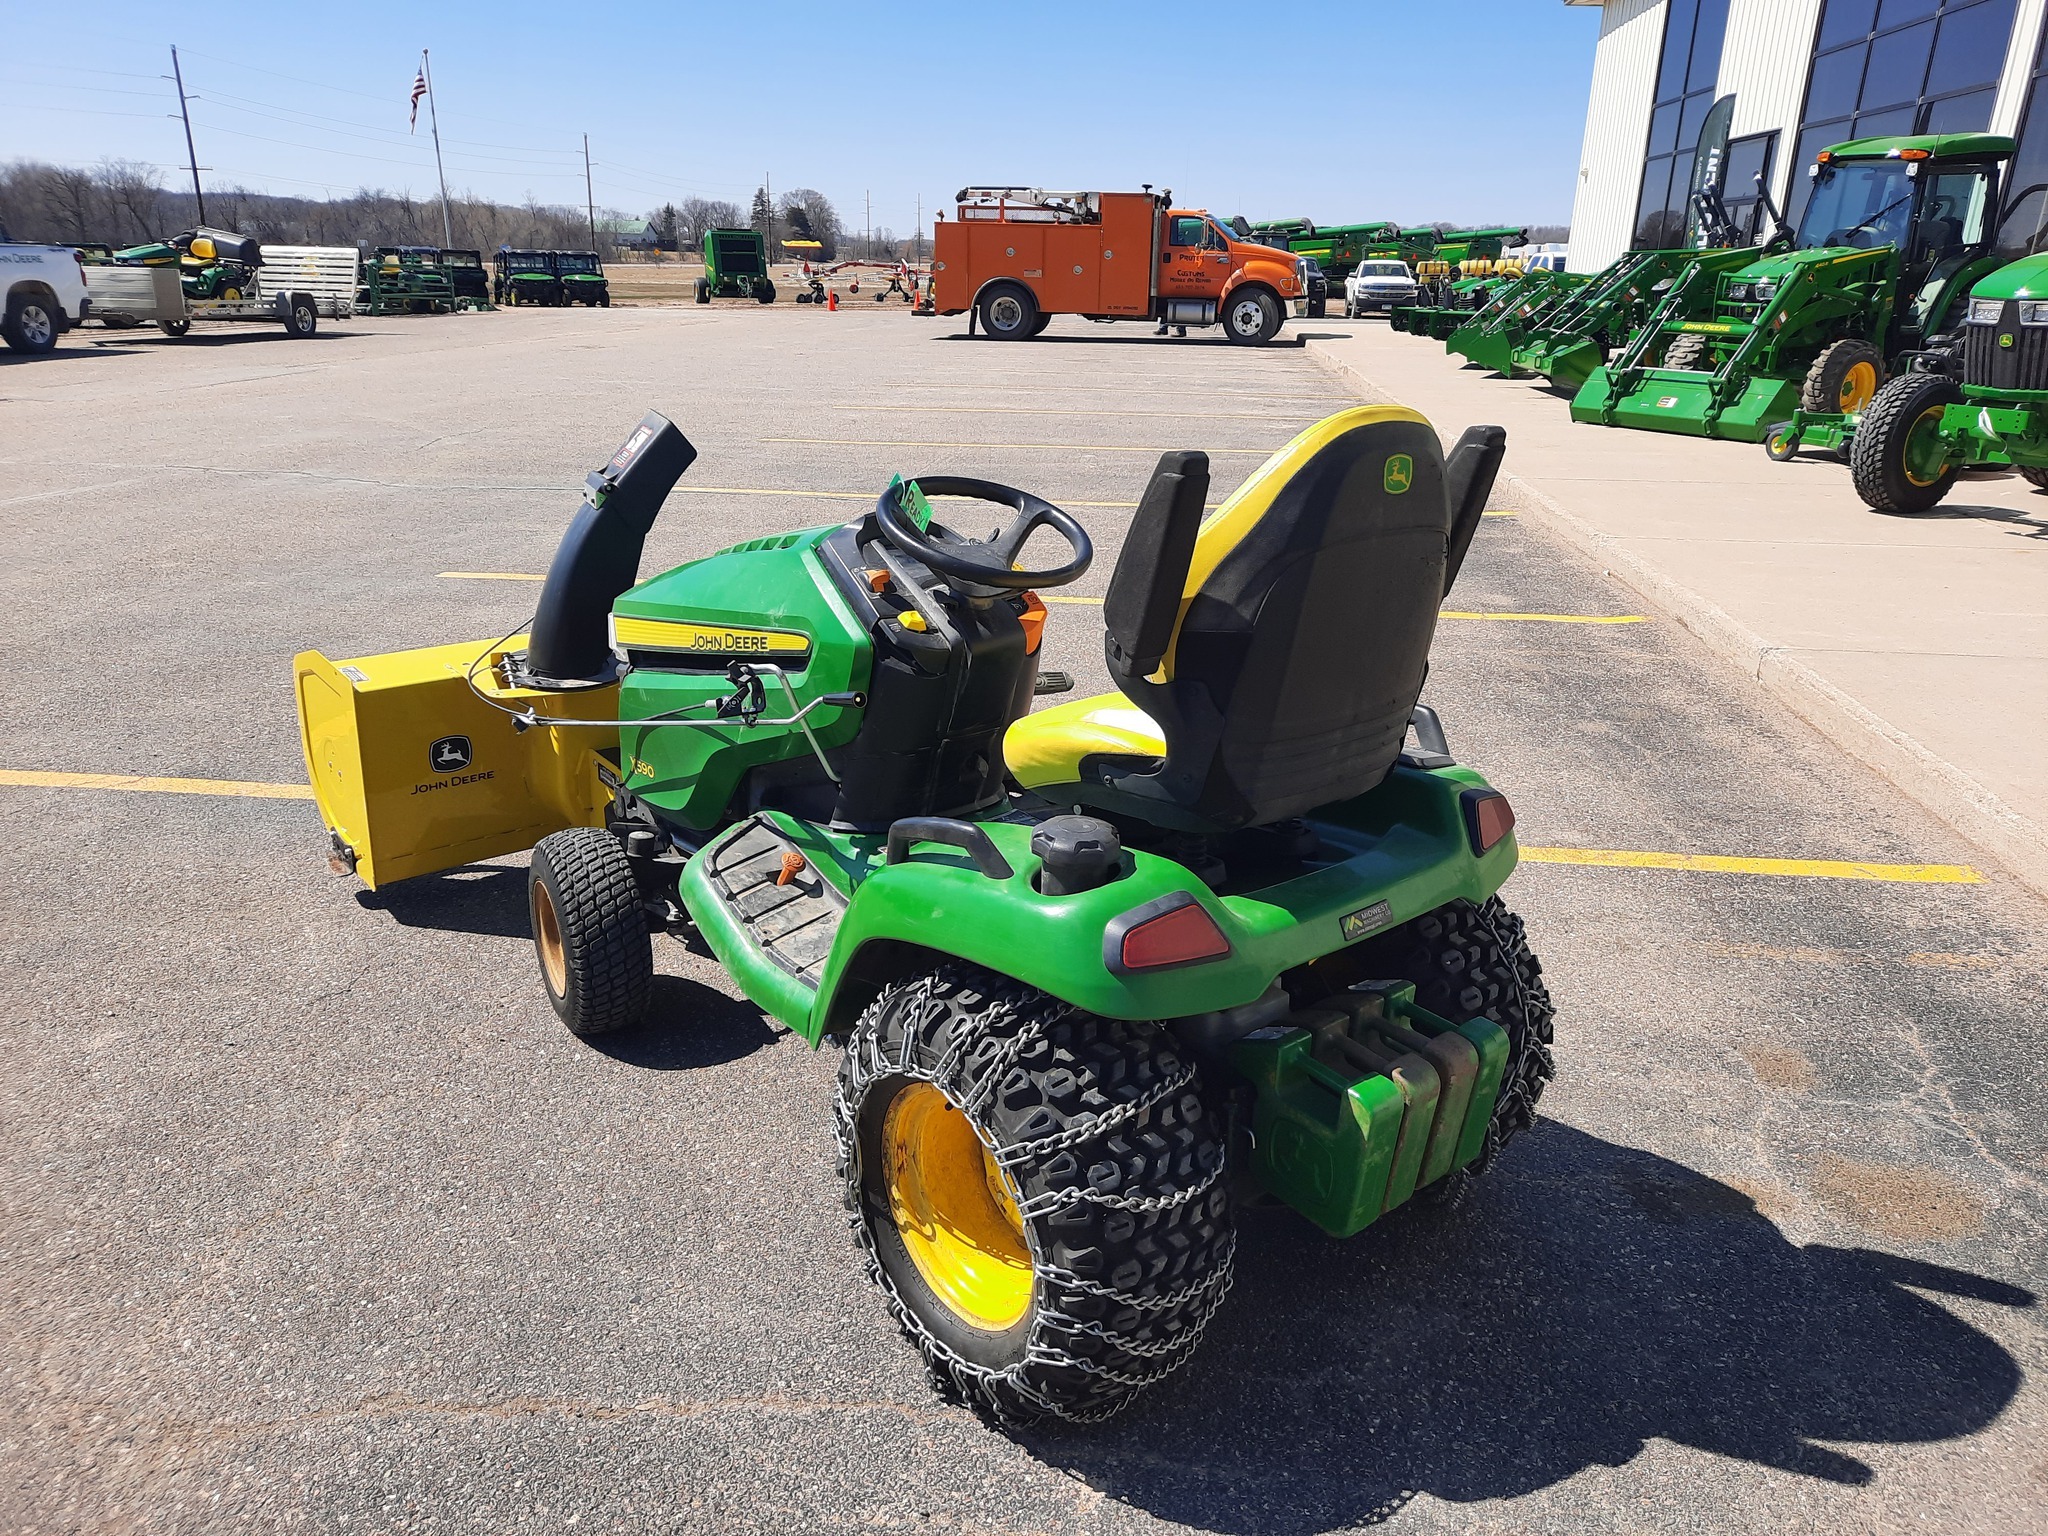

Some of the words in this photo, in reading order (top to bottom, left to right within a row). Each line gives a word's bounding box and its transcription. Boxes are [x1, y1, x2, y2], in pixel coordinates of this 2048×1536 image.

[12, 253, 45, 264] DEERE
[1681, 322, 1703, 331] JOHN
[1703, 323, 1731, 332] DEERE
[905, 490, 927, 525] READY
[690, 632, 722, 649] JOHN
[725, 633, 768, 650] DEERE
[629, 753, 655, 779] X590
[410, 780, 448, 795] JOHN
[451, 770, 495, 787] DEERE
